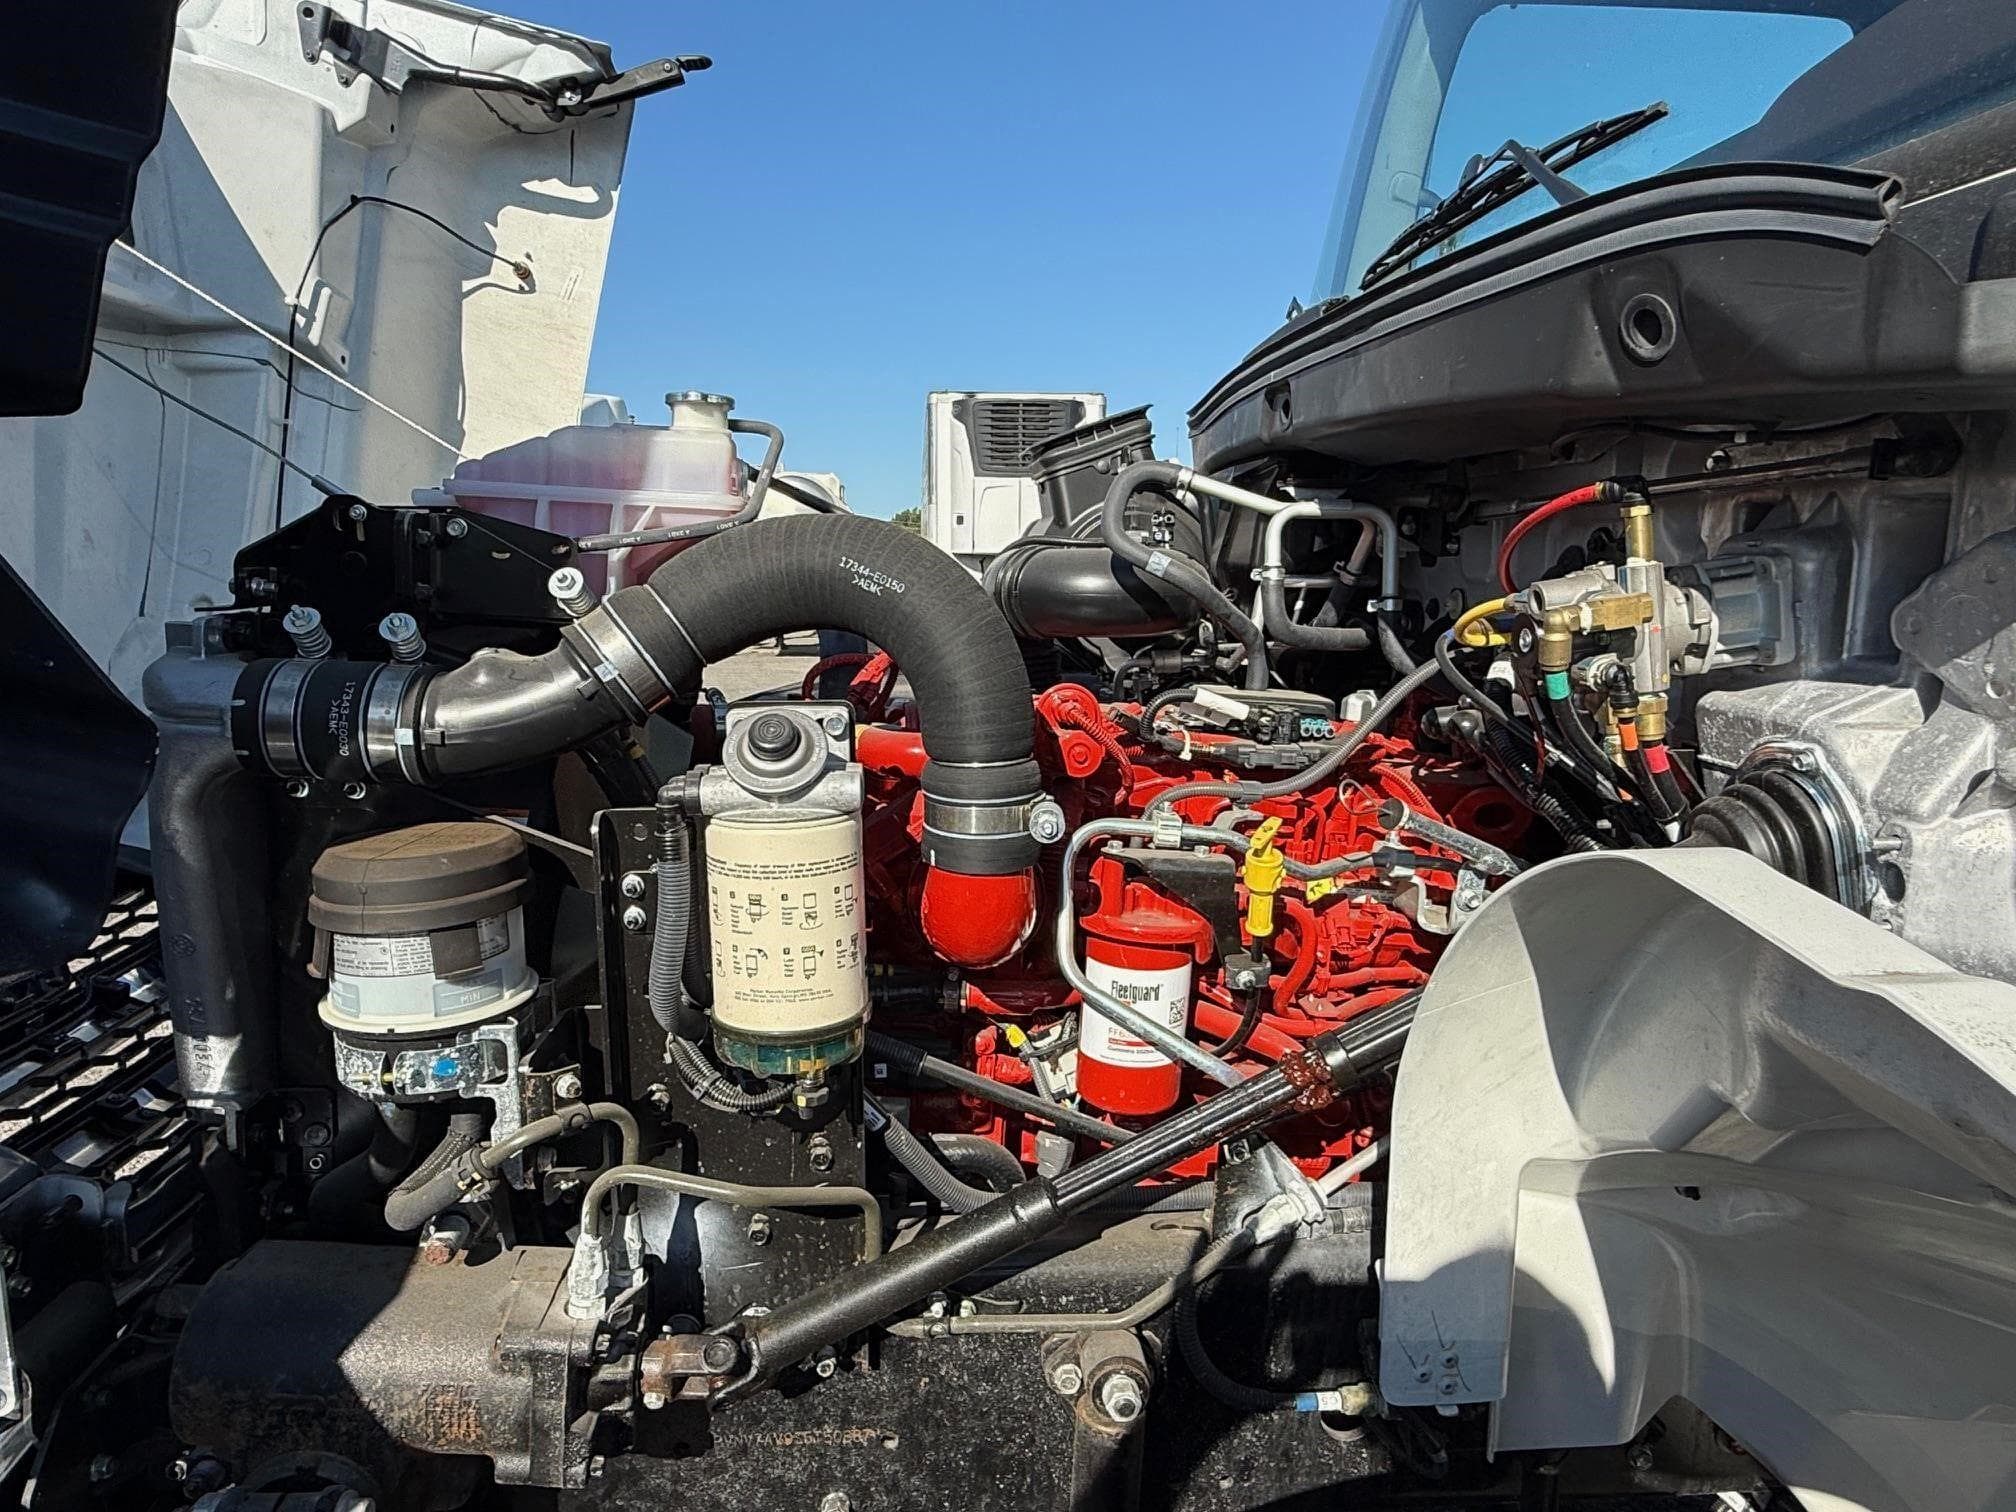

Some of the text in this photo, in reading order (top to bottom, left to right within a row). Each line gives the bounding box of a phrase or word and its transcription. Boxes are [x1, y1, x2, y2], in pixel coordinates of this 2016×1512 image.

[838, 556, 905, 594] 17344-E0150
[338, 681, 356, 756] 17343-E0030
[461, 991, 480, 1005] MIN
[1111, 980, 1160, 1004] Fleetguard
